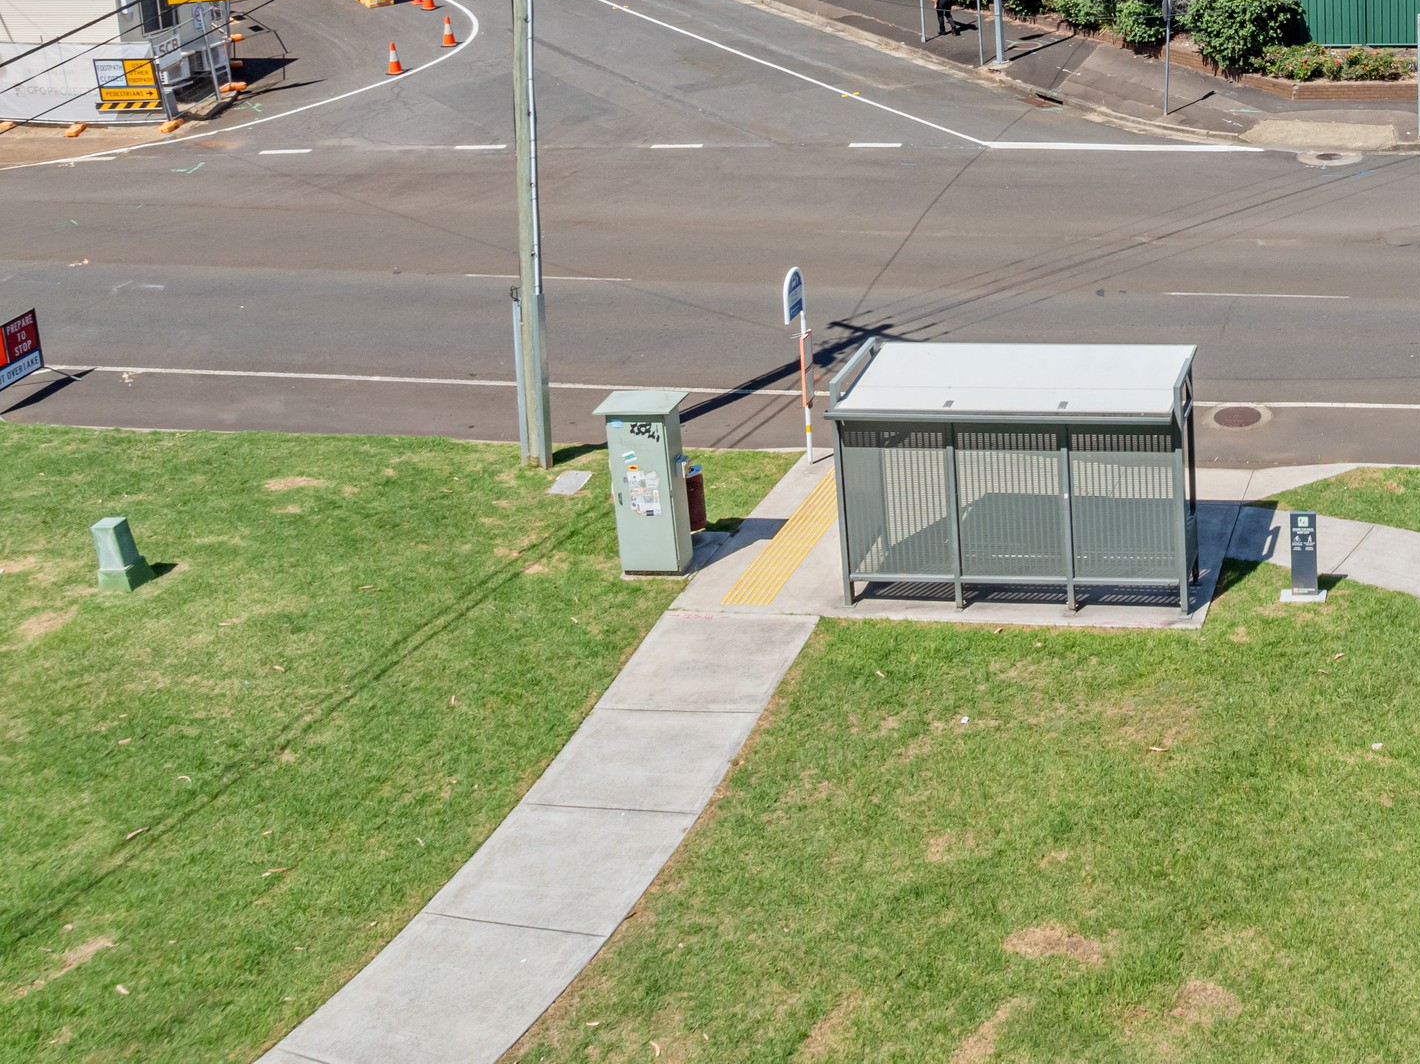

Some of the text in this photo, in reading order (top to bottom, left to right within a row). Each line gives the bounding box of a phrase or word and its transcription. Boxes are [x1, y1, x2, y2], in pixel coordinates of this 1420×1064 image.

[97, 64, 123, 72] FOOTPATH
[6, 313, 34, 336] PREPARE
[17, 330, 27, 343] TO
[14, 339, 32, 357] STOP
[7, 355, 39, 380] OVERTAKE
